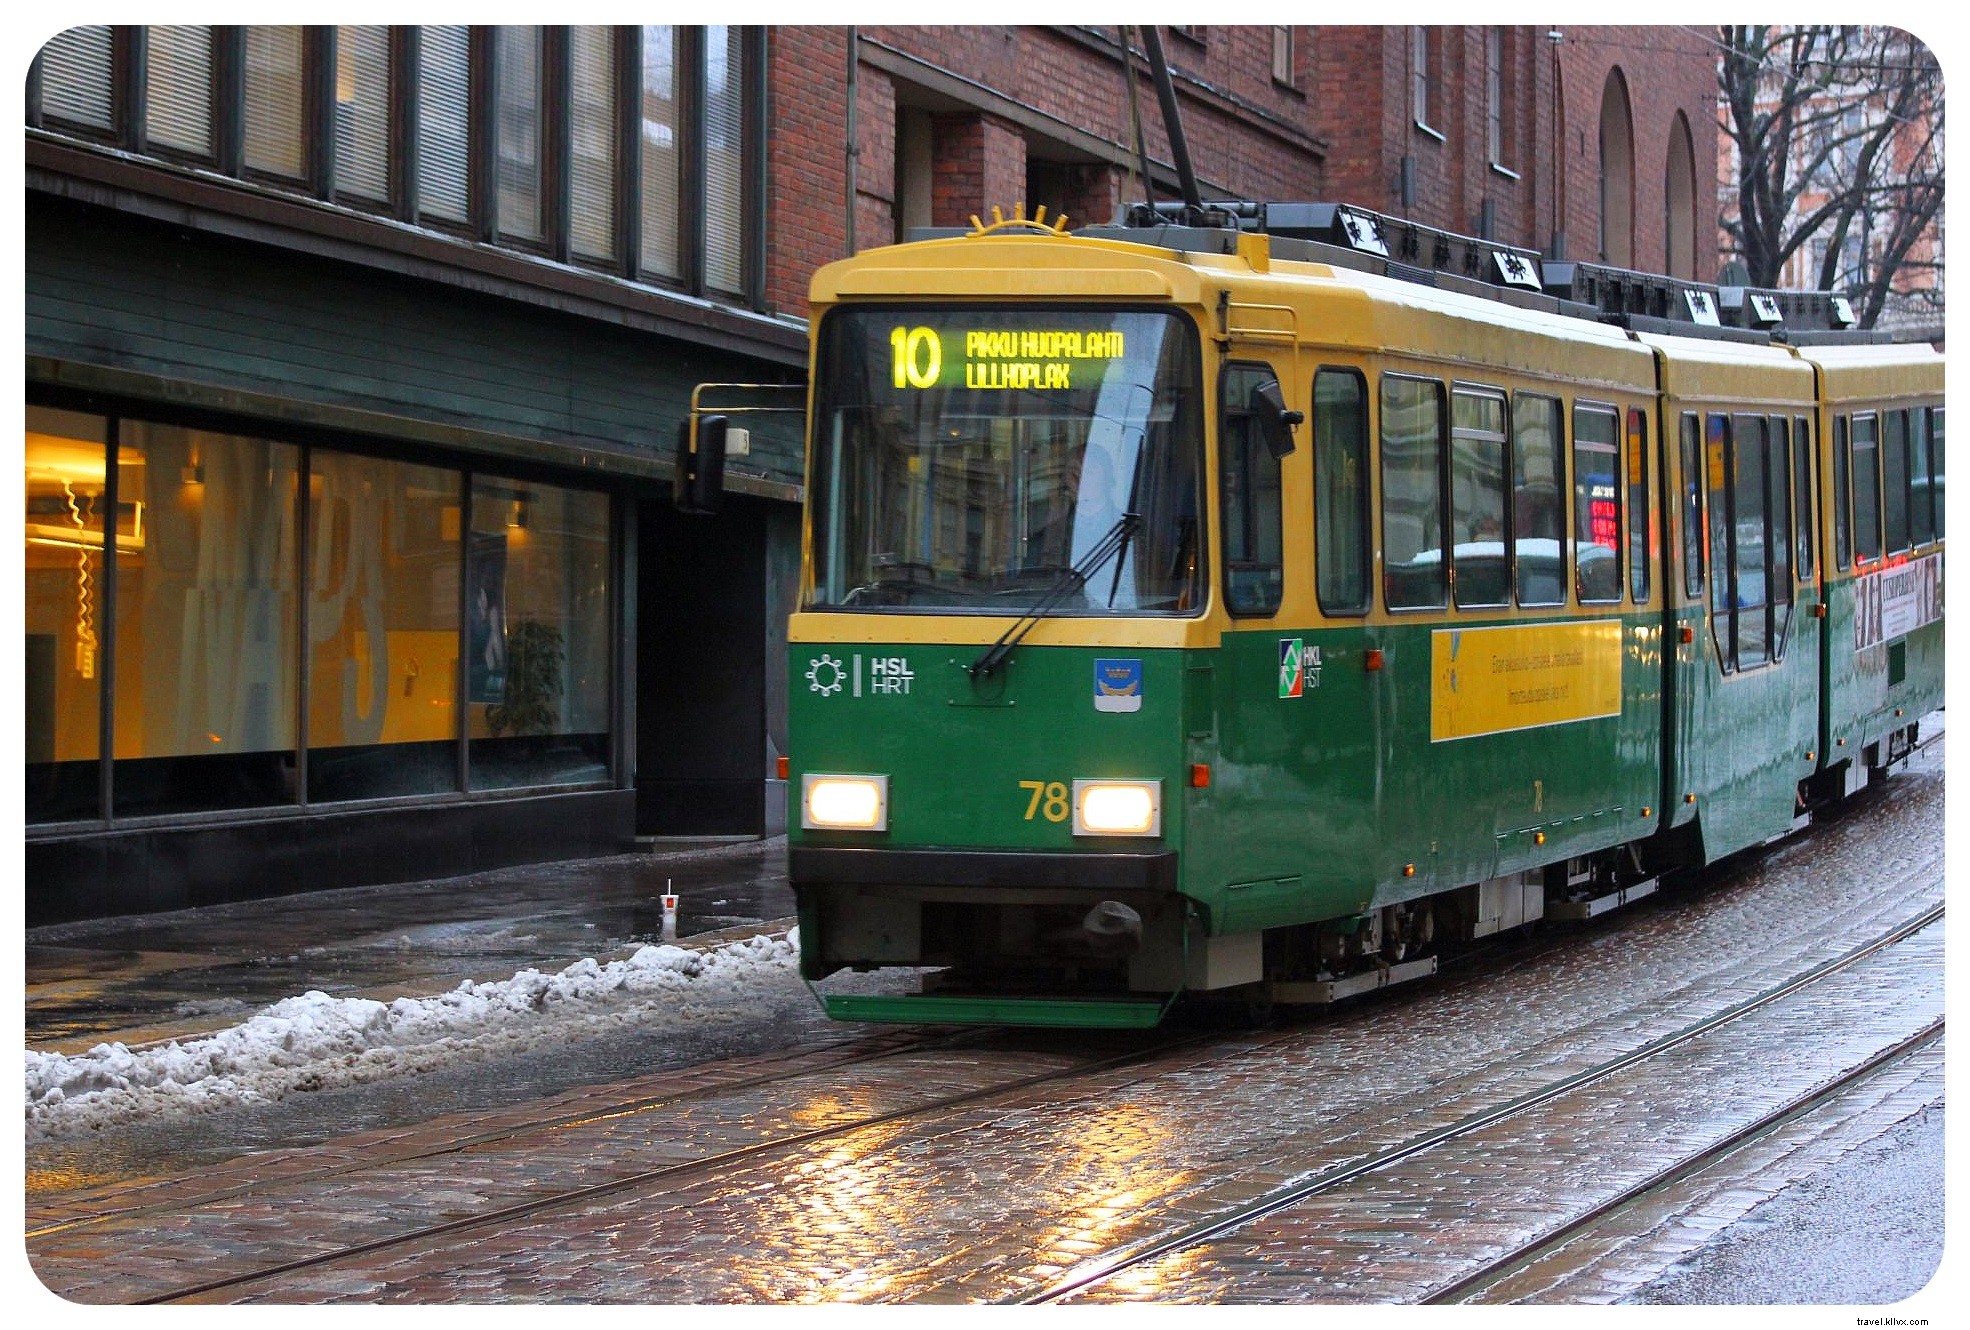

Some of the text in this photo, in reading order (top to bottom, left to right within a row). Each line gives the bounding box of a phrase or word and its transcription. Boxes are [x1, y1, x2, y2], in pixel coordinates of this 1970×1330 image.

[967, 332, 1018, 358] PIKKU
[891, 326, 942, 389] 10
[1303, 646, 1321, 665] HKL
[871, 658, 912, 676] HSL
[1304, 667, 1321, 688] HST
[871, 676, 915, 695] HRT
[1018, 781, 1068, 823] 78
